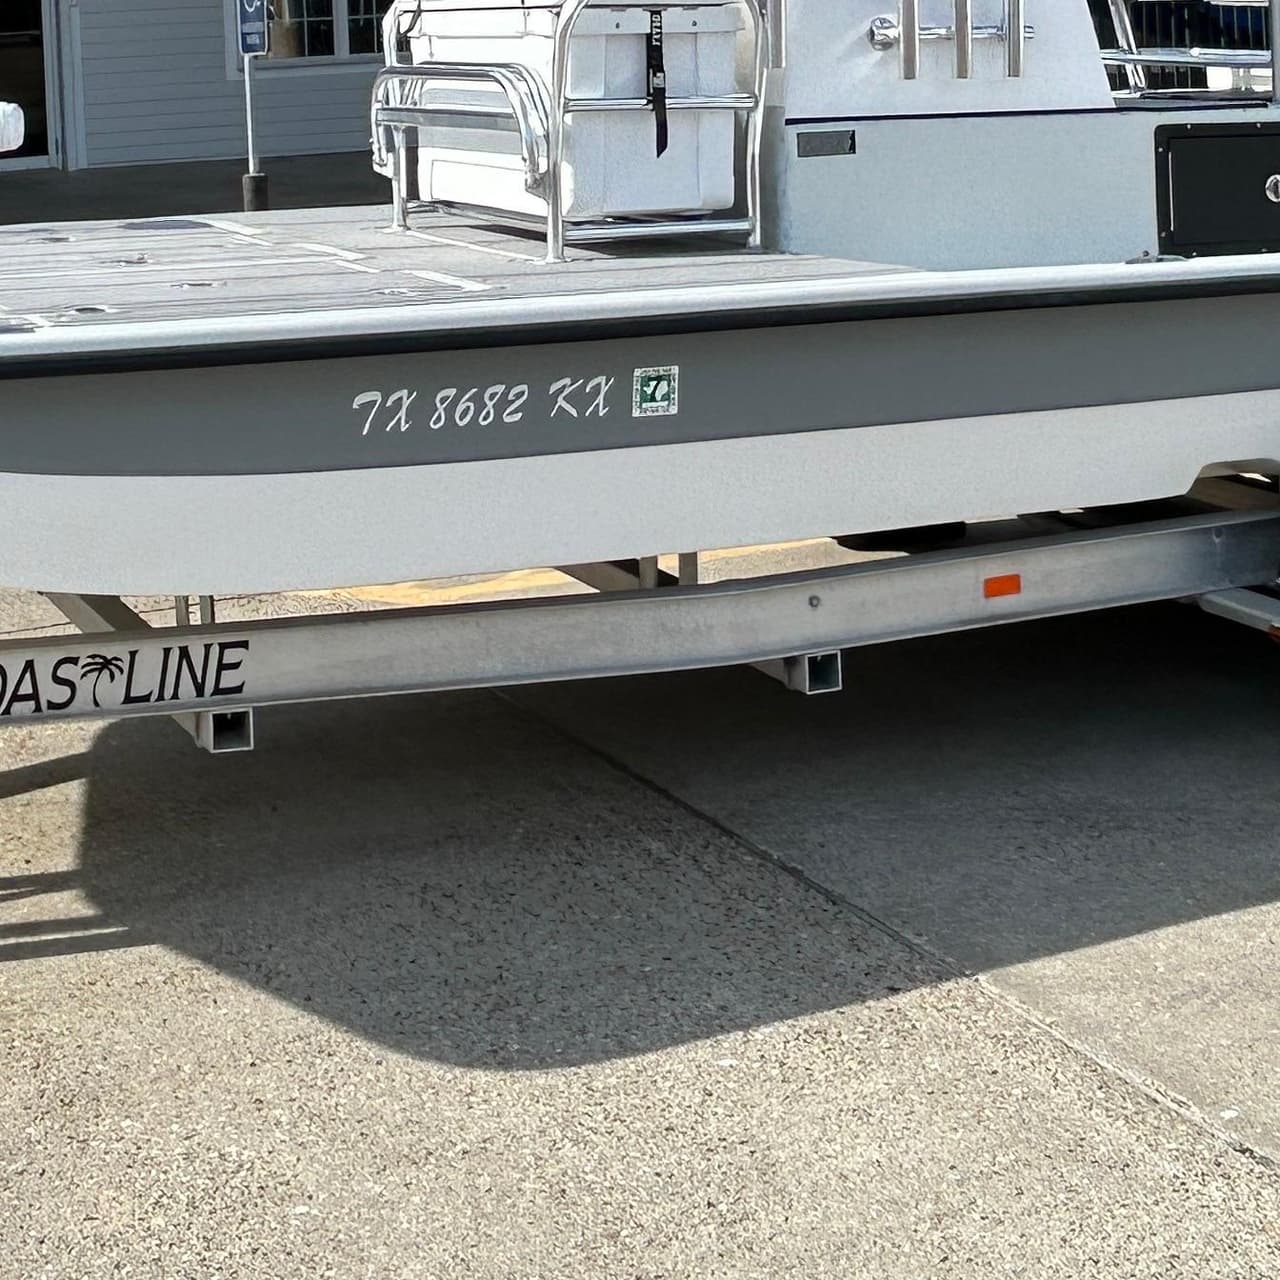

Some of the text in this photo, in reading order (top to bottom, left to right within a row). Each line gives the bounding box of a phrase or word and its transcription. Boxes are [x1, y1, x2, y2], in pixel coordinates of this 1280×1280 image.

[352, 375, 615, 435] TX 8682 KX
